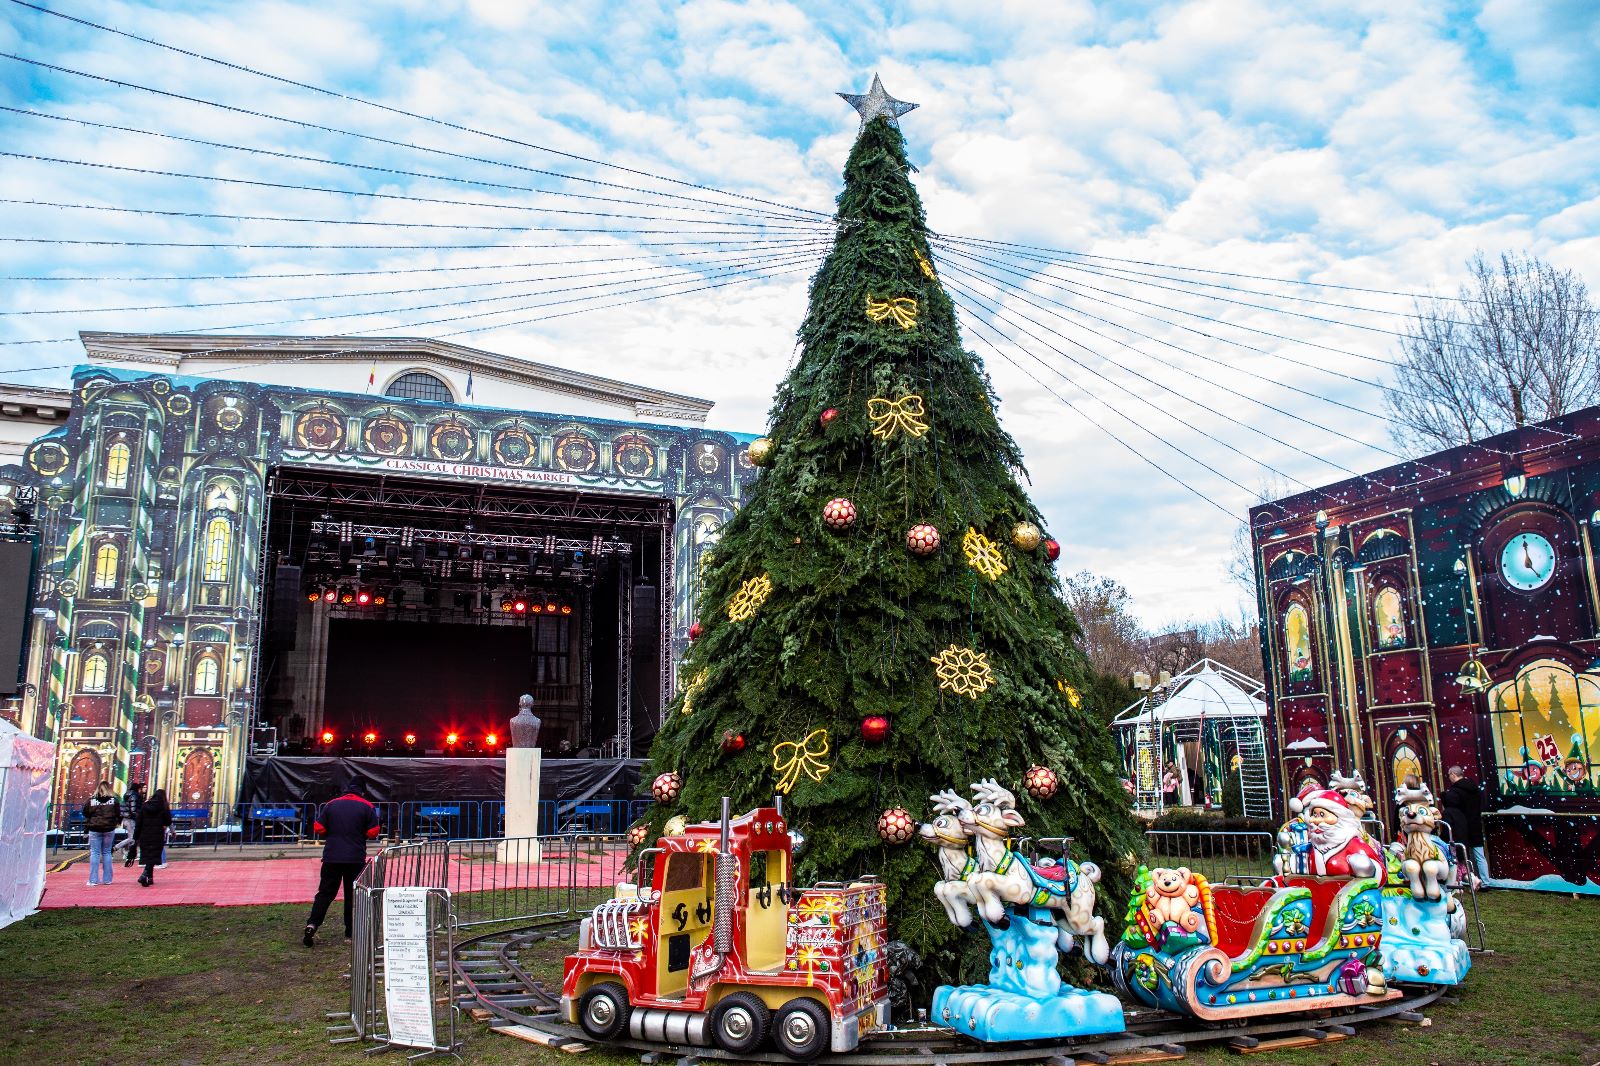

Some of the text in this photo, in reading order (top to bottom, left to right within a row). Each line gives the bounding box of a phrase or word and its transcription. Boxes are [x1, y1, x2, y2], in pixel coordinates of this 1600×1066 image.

[386, 460, 573, 483] CLASSICAL CHRISTMAS MARKET
[1536, 735, 1558, 762] 25
